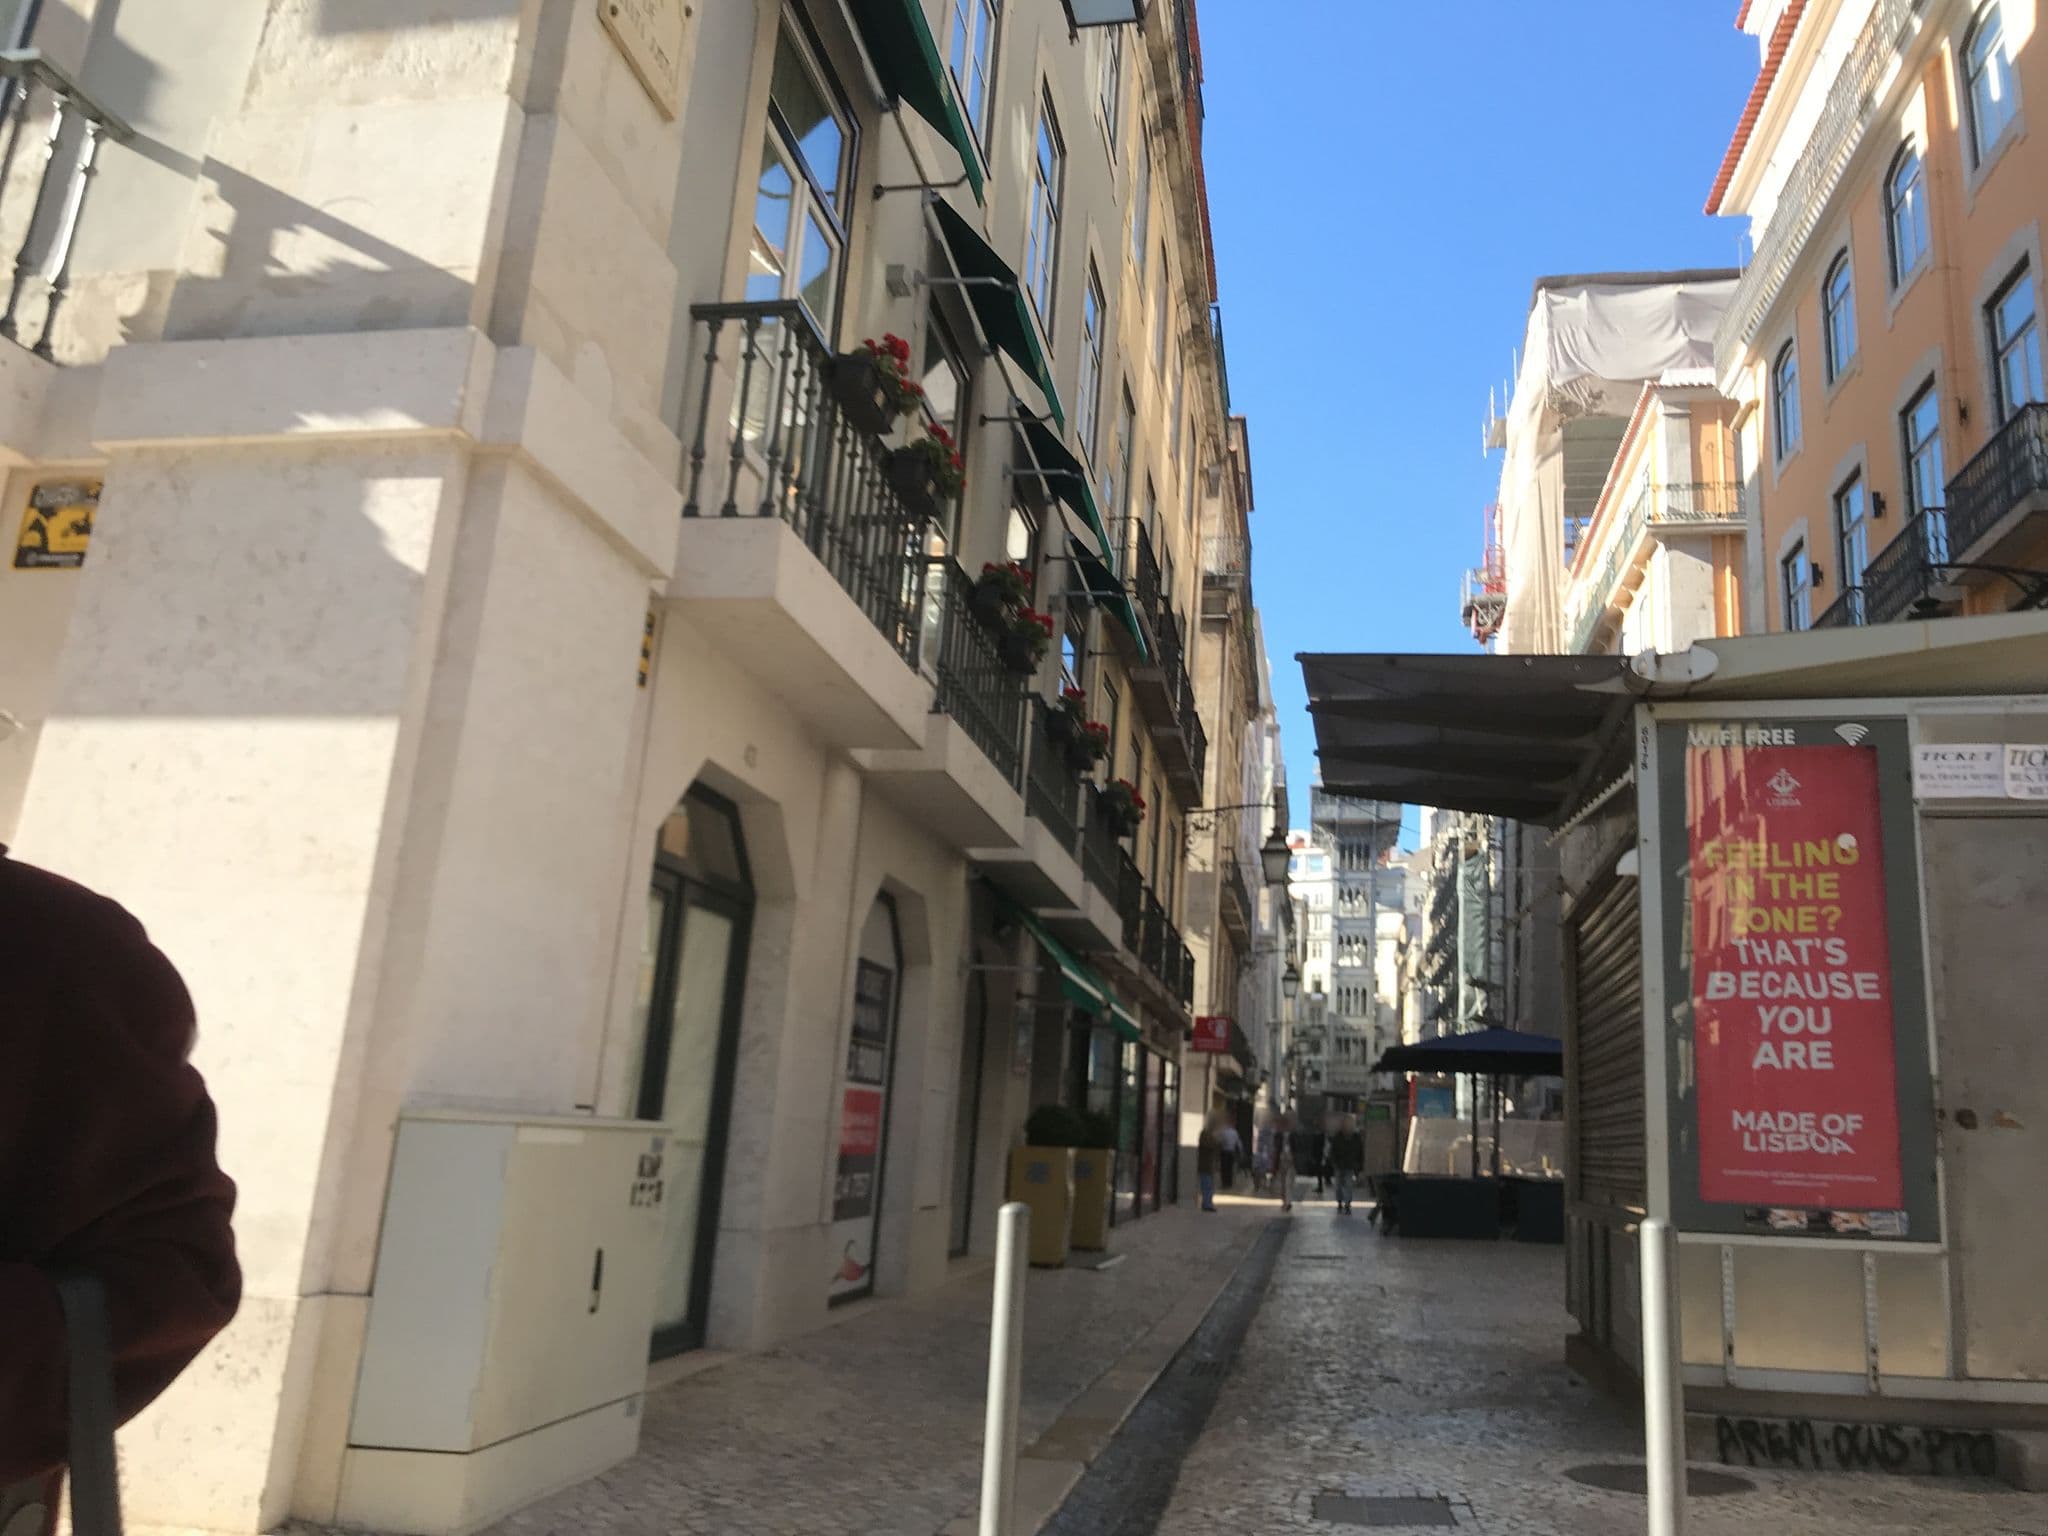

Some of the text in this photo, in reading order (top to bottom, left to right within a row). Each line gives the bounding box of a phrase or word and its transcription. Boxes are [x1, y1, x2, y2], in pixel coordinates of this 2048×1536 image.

[1745, 728, 1796, 745] FREE
[1703, 838, 1860, 869] FEELING
[1725, 872, 1841, 900] IN THE
[1728, 905, 1843, 935] ZONE?
[1731, 937, 1848, 966] THAT'S
[1706, 971, 1881, 1000] BECAUSE
[1757, 1005, 1832, 1035] YOU
[1752, 1041, 1834, 1070] ARE
[1732, 1109, 1864, 1135] MADE OF
[1743, 1131, 1856, 1155] LISBOA
